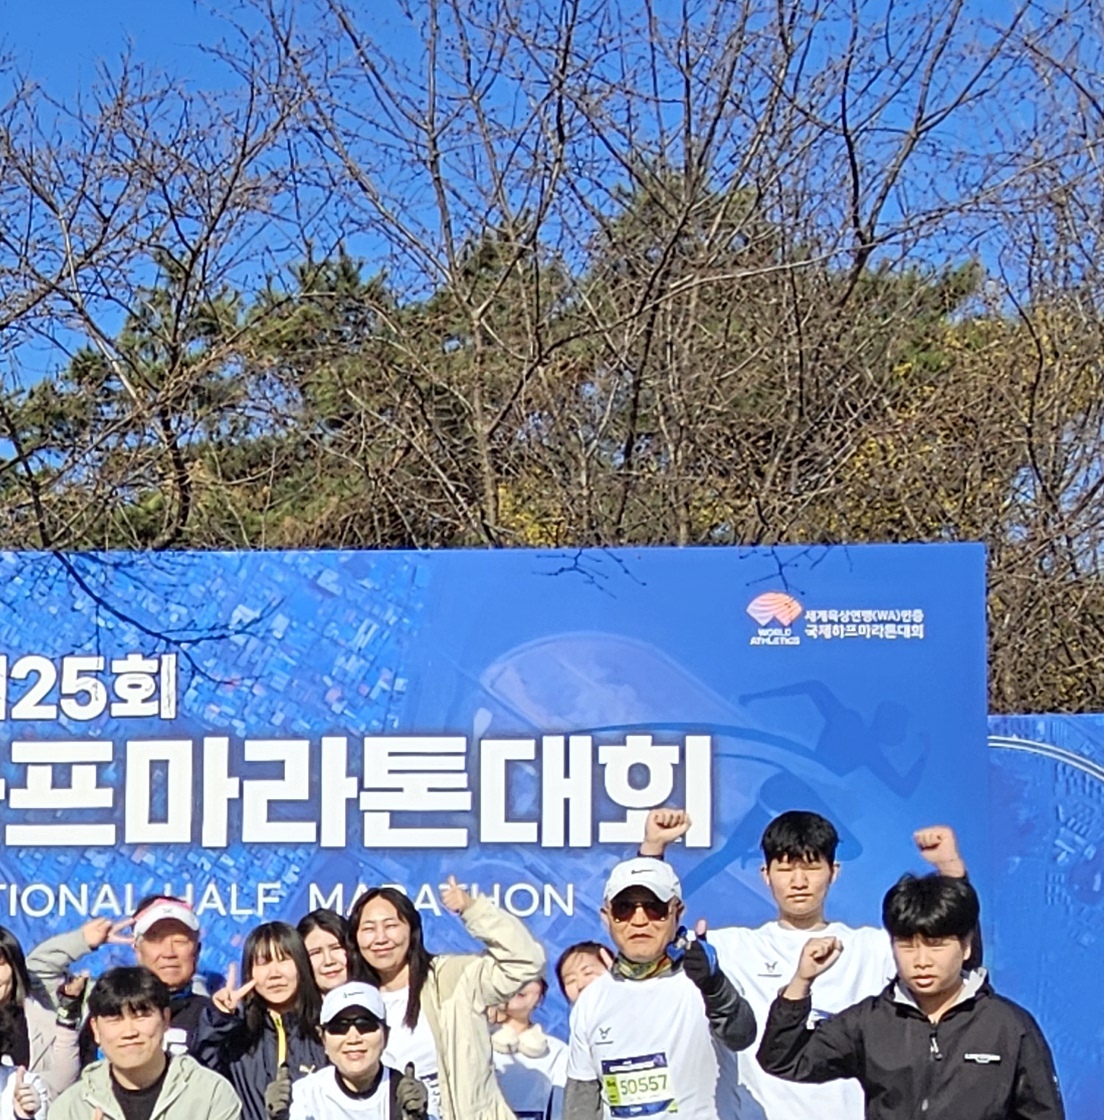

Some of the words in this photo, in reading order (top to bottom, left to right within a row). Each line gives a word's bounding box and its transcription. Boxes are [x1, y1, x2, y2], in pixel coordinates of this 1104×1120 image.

[757, 628, 792, 637] WORLD
[804, 624, 925, 639] 국제하프마라톤대회
[750, 636, 801, 645] ATHLETICS
[619, 1073, 668, 1096] 50557
